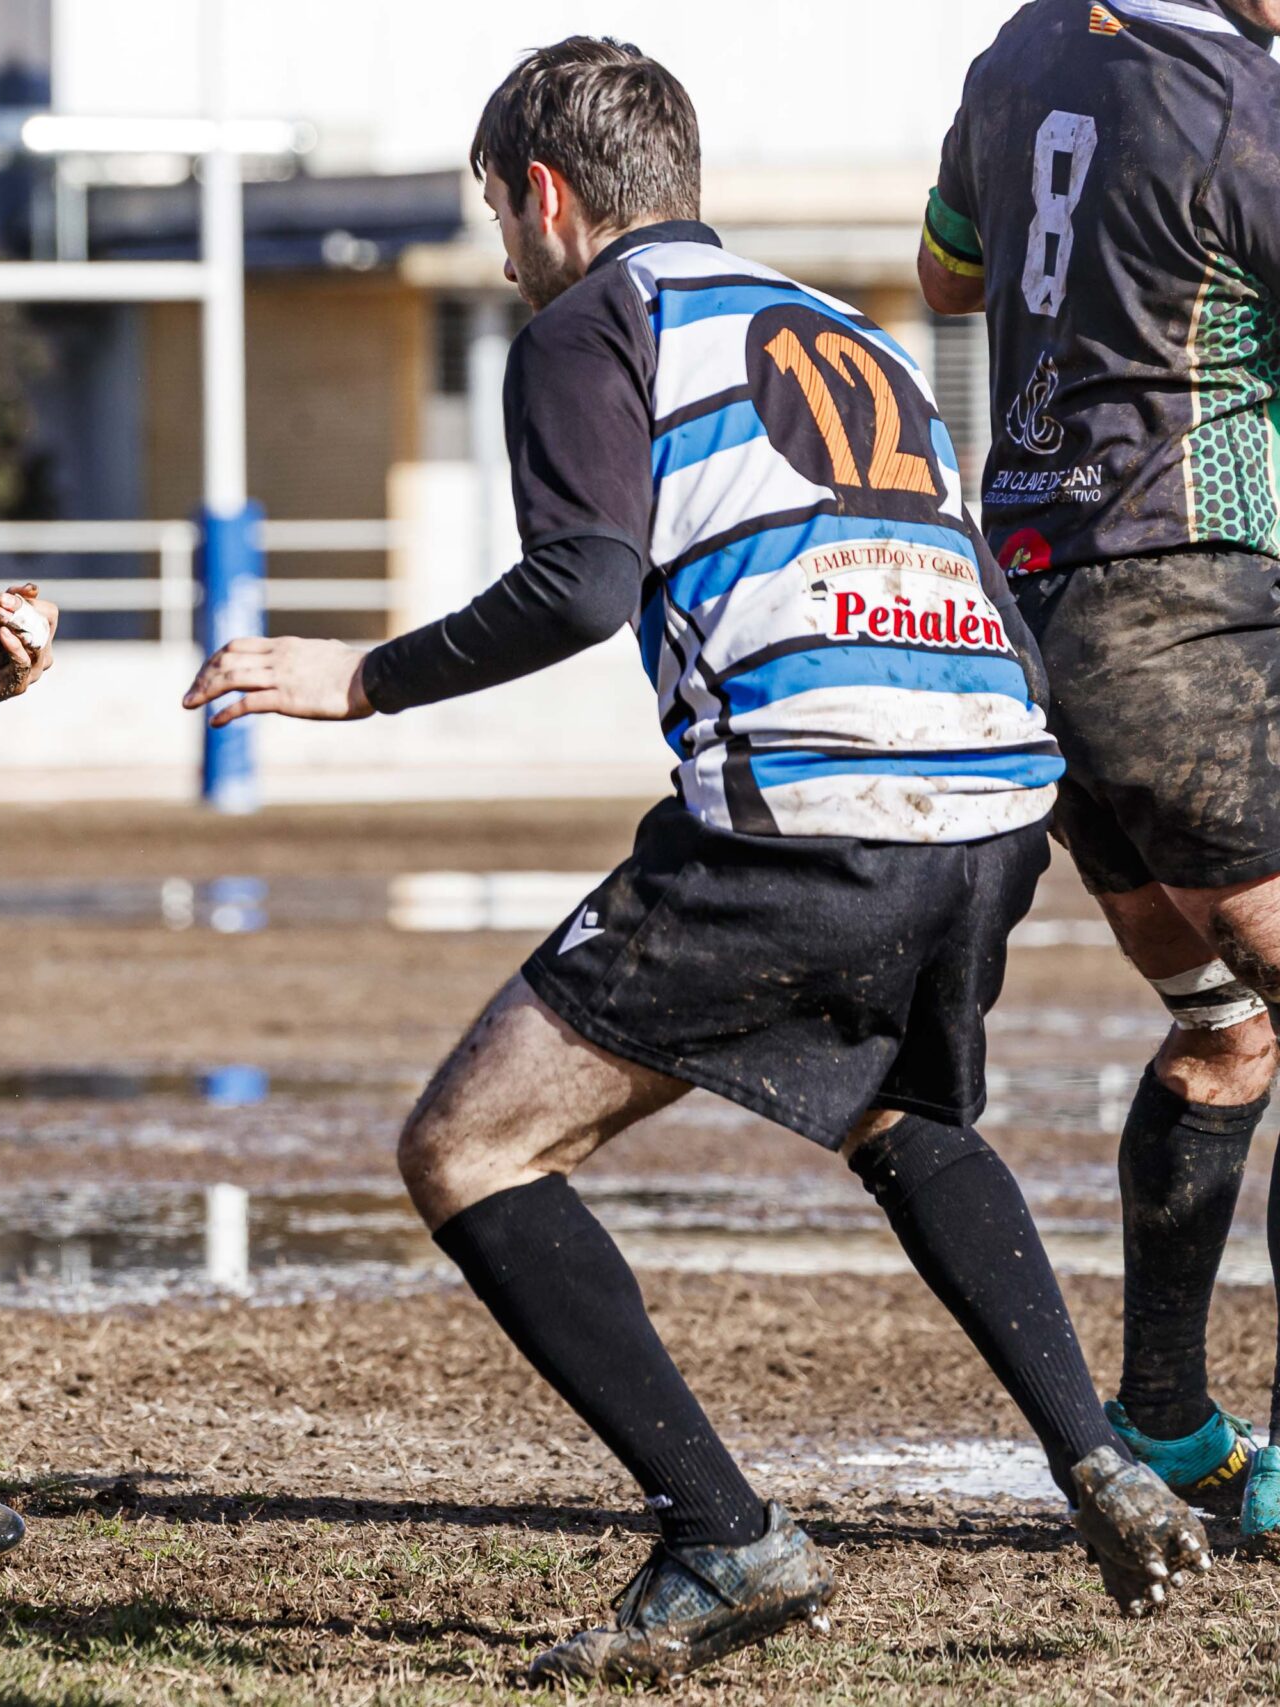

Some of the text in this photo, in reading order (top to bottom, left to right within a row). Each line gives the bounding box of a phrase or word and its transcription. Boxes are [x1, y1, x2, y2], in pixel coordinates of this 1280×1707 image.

[1022, 109, 1097, 318] 8
[764, 327, 937, 496] 12
[992, 470, 1012, 489] EN
[1011, 471, 1048, 491] CLAVE
[814, 548, 914, 574] EMBUTIDOS
[917, 554, 927, 568] Y
[932, 556, 977, 583] CARN
[834, 592, 1005, 648] Peñalén
